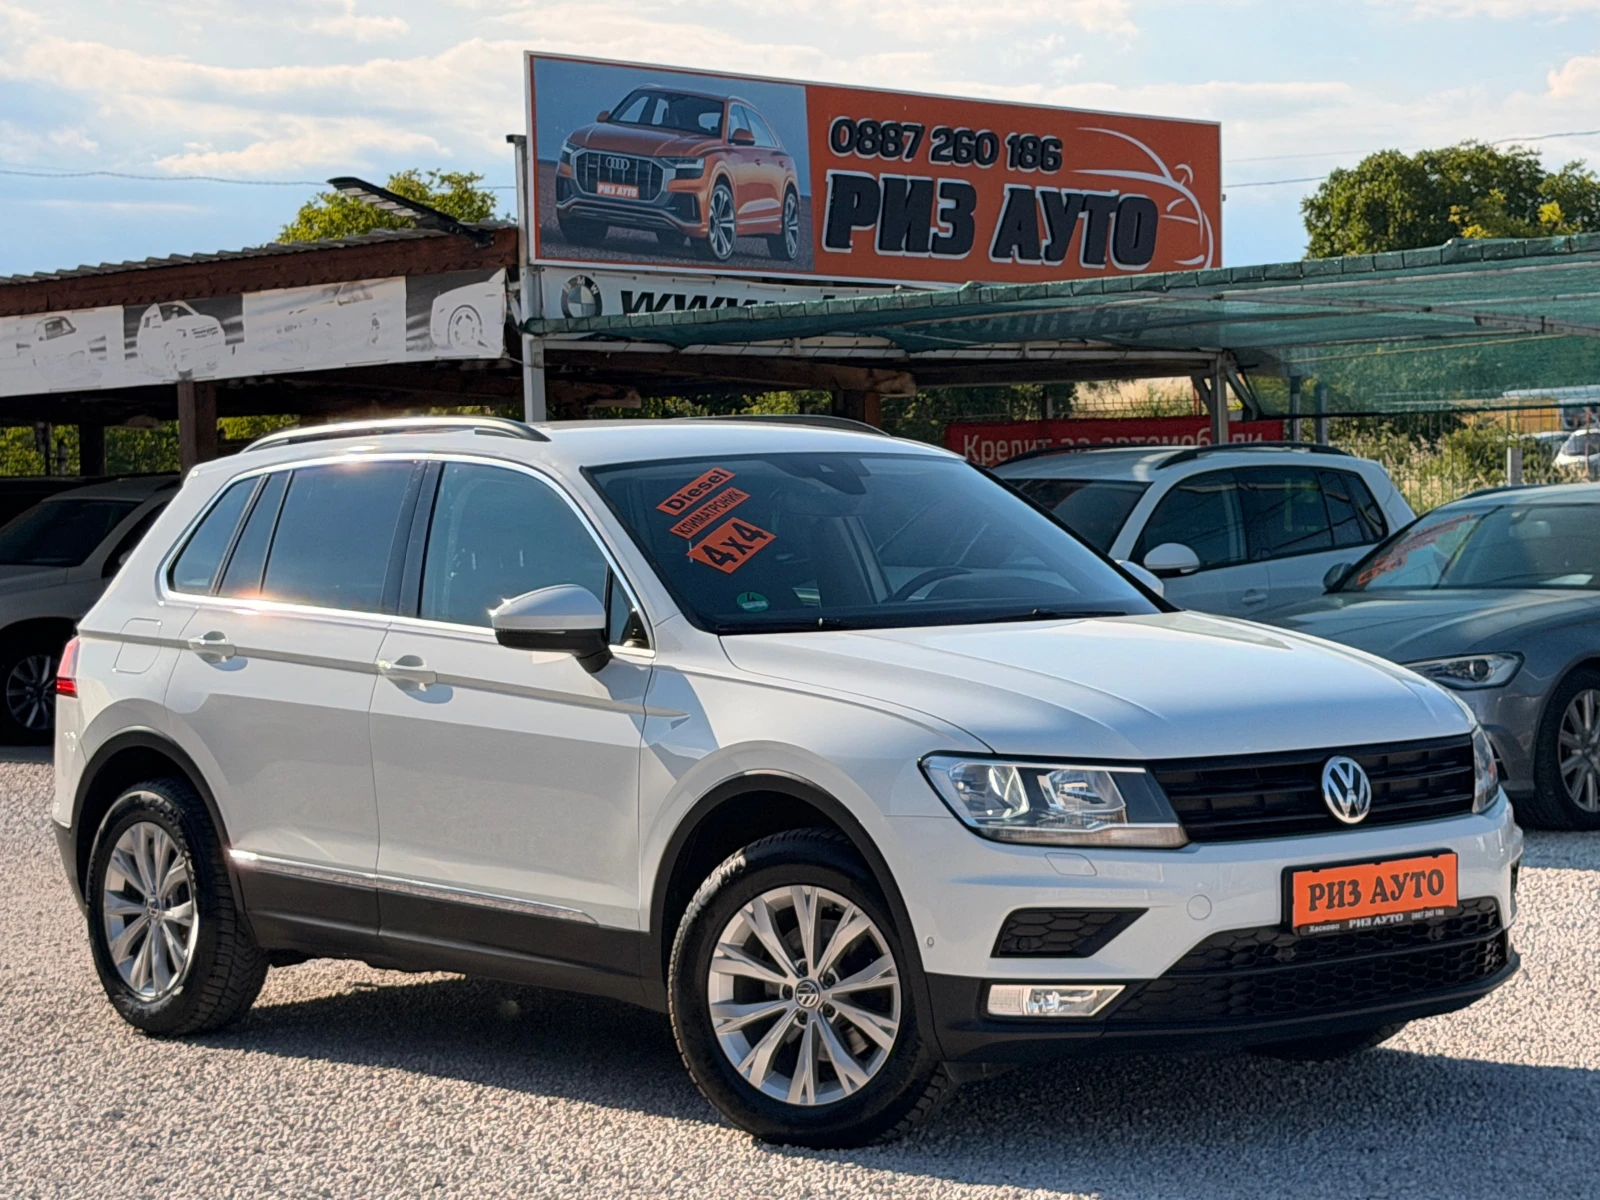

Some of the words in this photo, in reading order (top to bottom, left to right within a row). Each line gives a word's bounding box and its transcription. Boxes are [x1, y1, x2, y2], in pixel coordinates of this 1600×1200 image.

[828, 116, 925, 161] 0887
[928, 125, 999, 168] 260
[1005, 132, 1063, 174] 186
[822, 169, 977, 259] РИЗ
[989, 183, 1159, 271] АУТО
[664, 469, 728, 511] Diesel
[674, 490, 744, 536] КЛИМАТРОНИК
[1308, 879, 1362, 912] РИЗ
[1369, 869, 1444, 905] АУТО
[1348, 917, 1371, 929] РИЗ
[1373, 913, 1404, 926] АУТО
